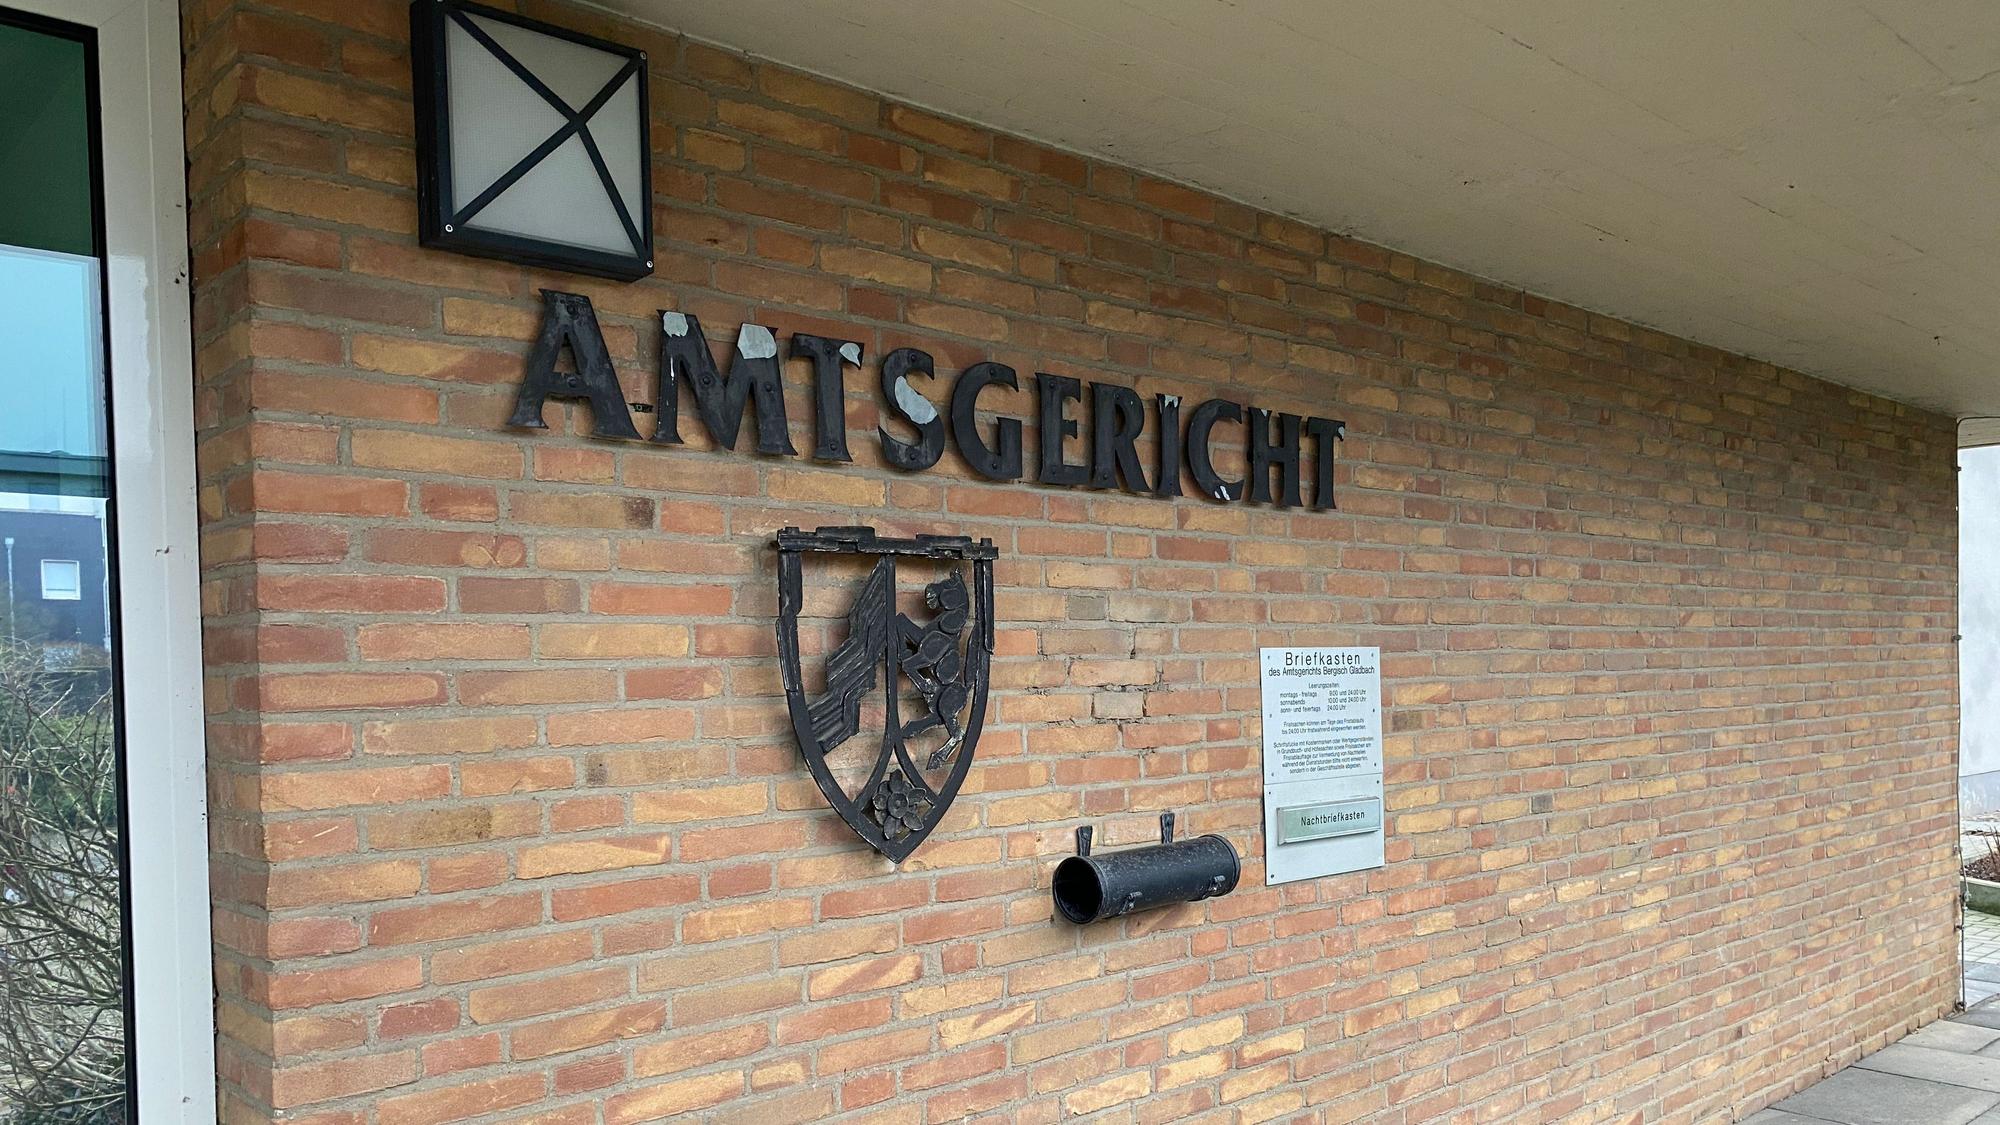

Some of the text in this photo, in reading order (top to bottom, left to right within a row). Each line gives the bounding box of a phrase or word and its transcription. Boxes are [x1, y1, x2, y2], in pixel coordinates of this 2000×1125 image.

[510, 289, 1345, 510] AMTSGERICHT
[1286, 652, 1360, 665] Briefkasten
[1269, 666, 1375, 677] des Amtsgerichts Bergisch Gladbach
[1301, 811, 1364, 826] Nachtbriefkasten
